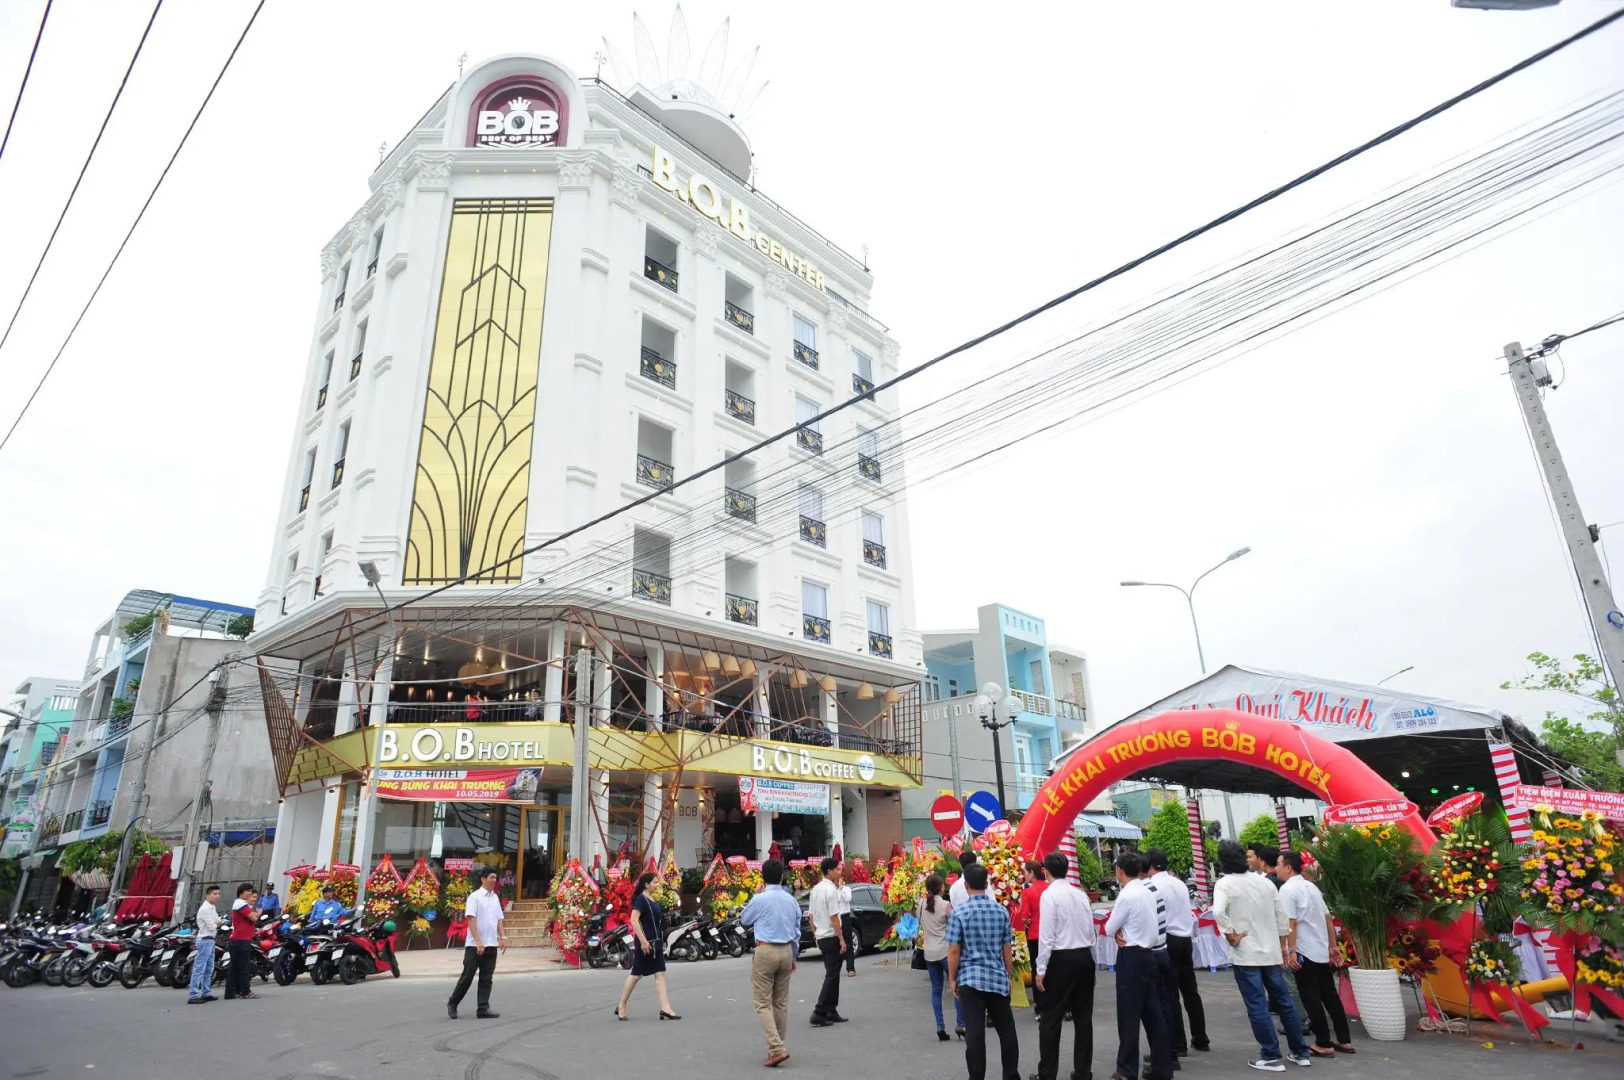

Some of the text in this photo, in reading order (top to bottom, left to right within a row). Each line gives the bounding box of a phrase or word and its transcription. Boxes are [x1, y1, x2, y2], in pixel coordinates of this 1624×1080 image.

[477, 110, 559, 135] BOB
[652, 144, 825, 292] B.O.B CENTER
[1288, 690, 1377, 731] Khách
[379, 728, 544, 762] B.O.B HOTEL
[753, 744, 855, 779] B.O.B COFFEE
[1060, 755, 1106, 795] KHAI
[1202, 727, 1256, 755] BOB
[1265, 742, 1332, 793] HOTEL
[432, 781, 458, 791] KHAI
[1563, 790, 1587, 801] XUÂN
